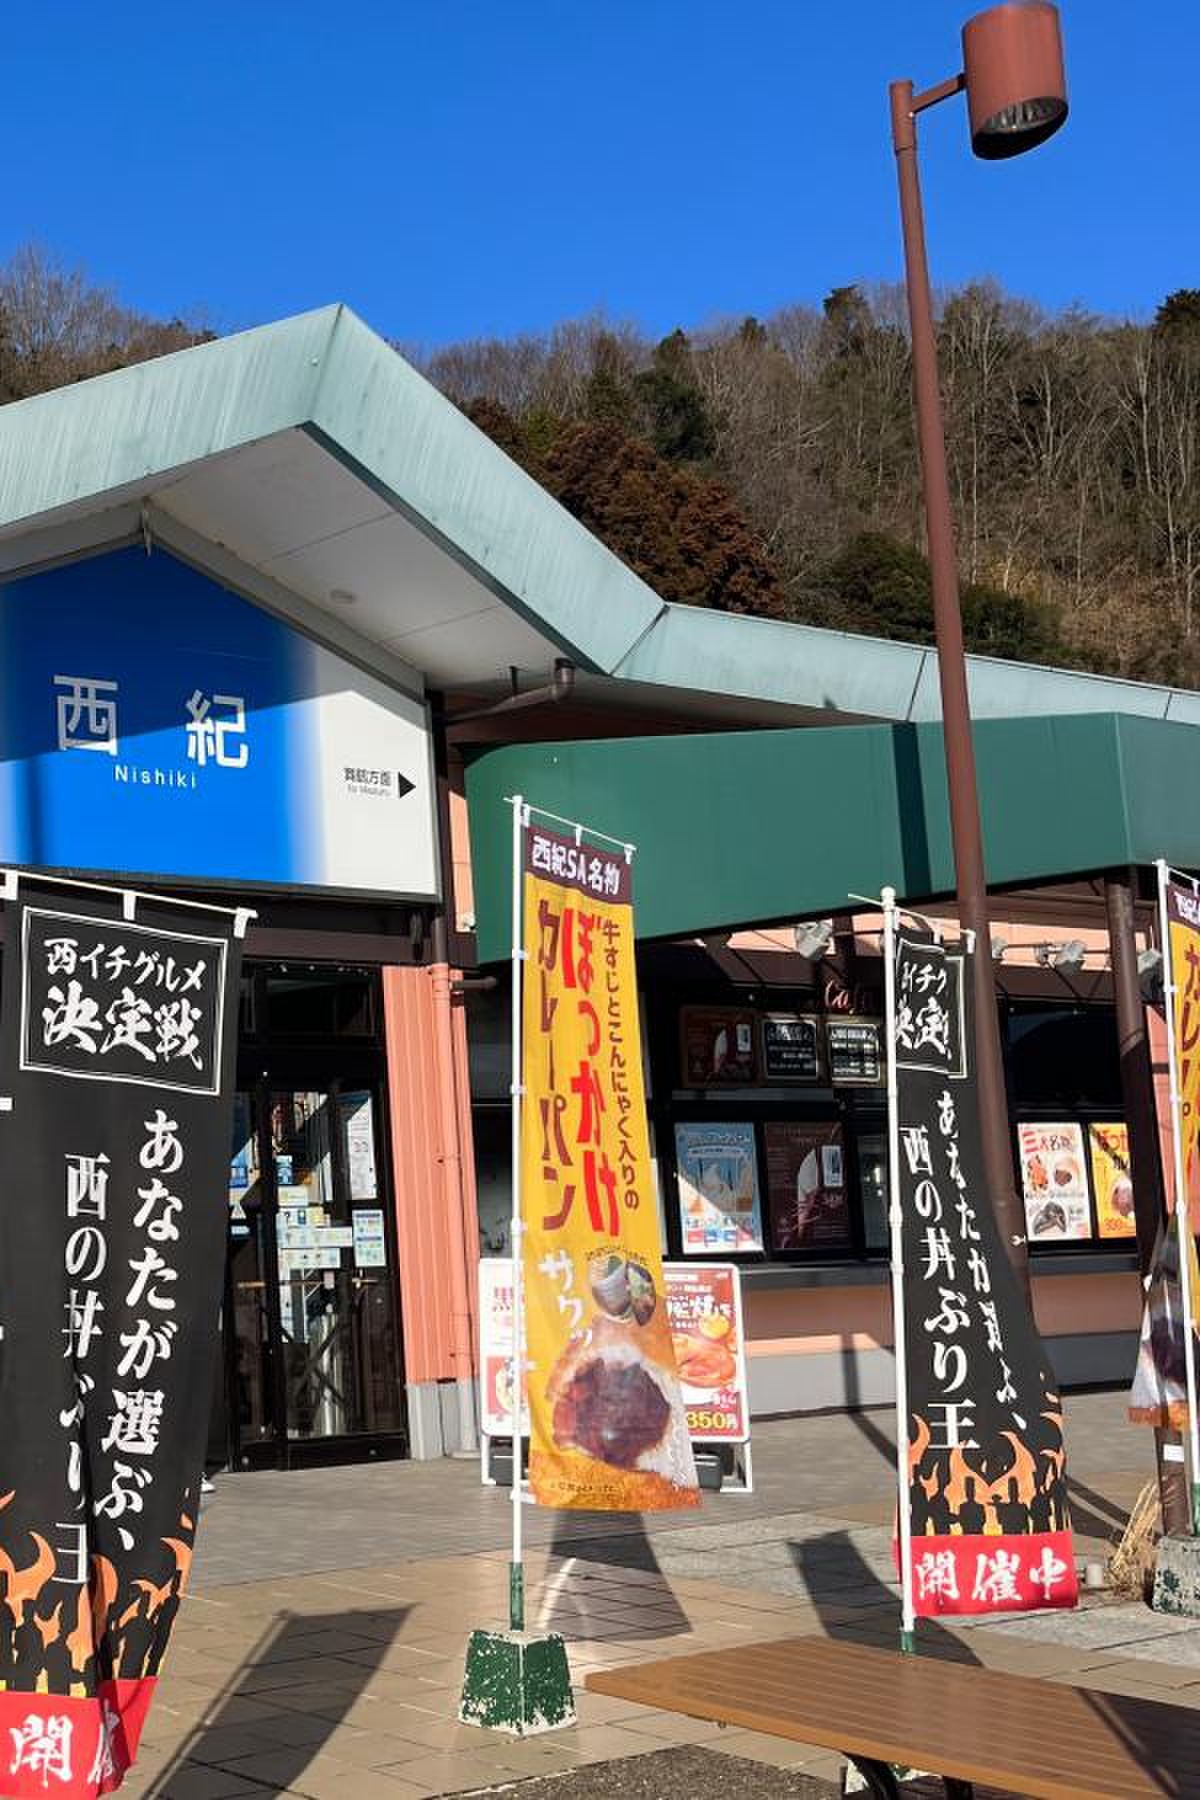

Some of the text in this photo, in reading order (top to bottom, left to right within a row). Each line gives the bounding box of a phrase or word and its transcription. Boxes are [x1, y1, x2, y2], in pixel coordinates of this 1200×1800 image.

[53, 674, 249, 770] 西紀
[115, 764, 198, 789] Nishiki
[531, 835, 620, 896] 西紀SA名物
[44, 937, 207, 993] 西イチグルメ
[42, 979, 204, 1071] 決定戦
[537, 899, 576, 1232] カレーパン
[602, 918, 640, 1210] 牛すじとこんにゃく入りの
[899, 1125, 981, 1450] 西の丼ぶり王
[915, 1547, 1068, 1605] 開催中
